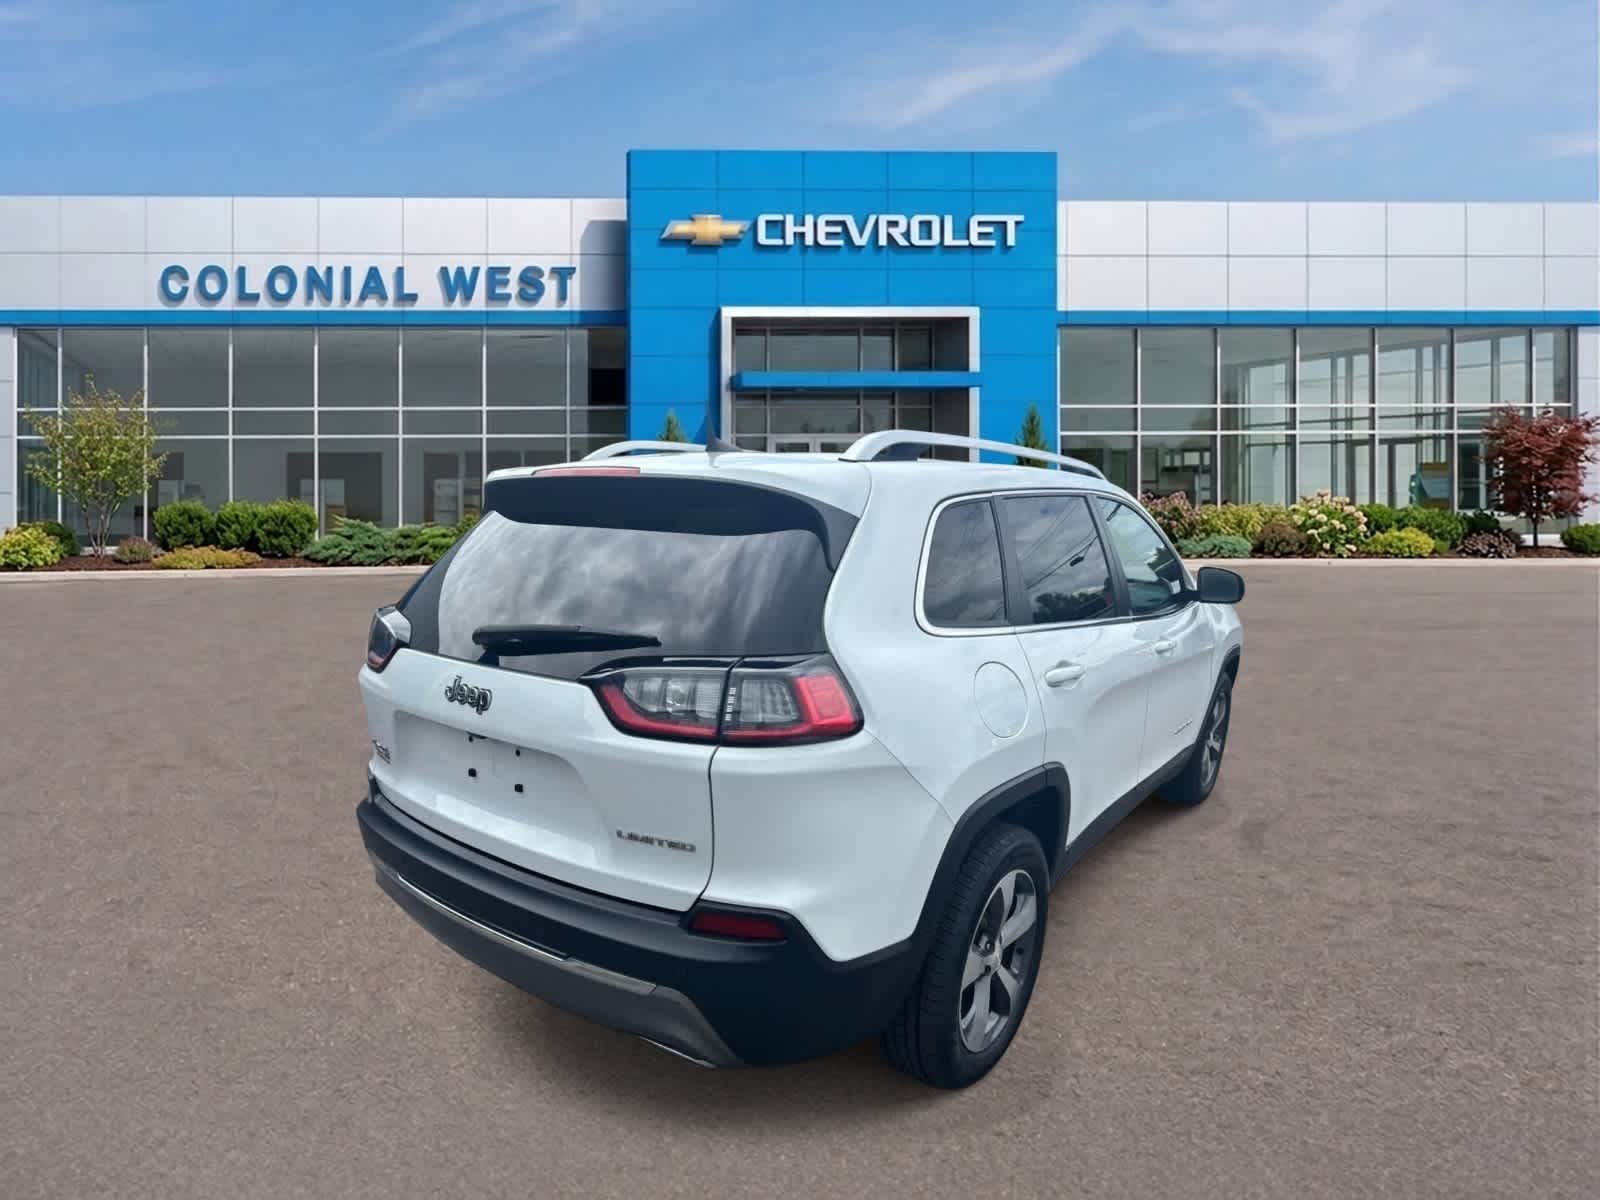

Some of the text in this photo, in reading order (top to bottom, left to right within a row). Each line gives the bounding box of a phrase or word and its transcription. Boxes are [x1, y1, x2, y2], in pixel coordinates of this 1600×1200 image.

[757, 213, 1025, 247] CHEVROLET
[159, 264, 577, 305] COLONIAL WEST
[445, 674, 493, 715] Jeep
[616, 829, 697, 853] LIMITED
